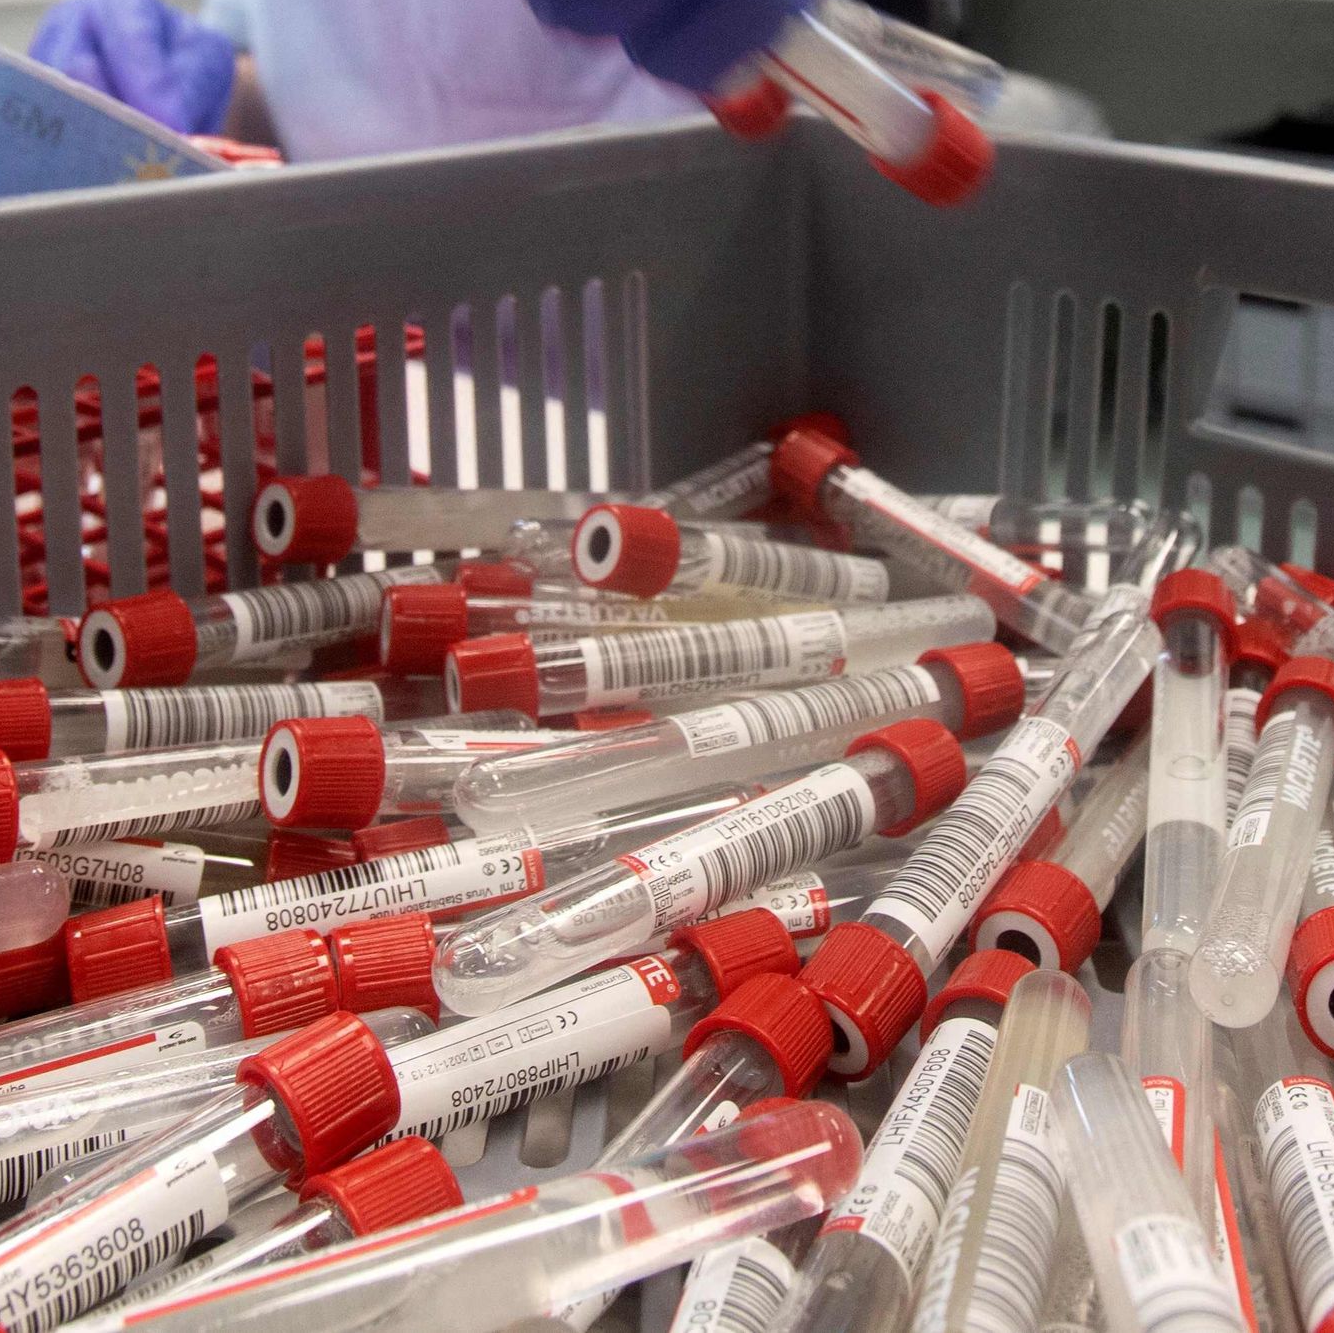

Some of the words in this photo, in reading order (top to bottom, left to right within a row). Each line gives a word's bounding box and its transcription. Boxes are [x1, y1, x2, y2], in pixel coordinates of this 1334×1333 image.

[465, 887, 494, 901] Virus
[517, 878, 526, 891] 2
[266, 878, 427, 931] LHIU77240808
[452, 1051, 580, 1108] LHIP88072408
